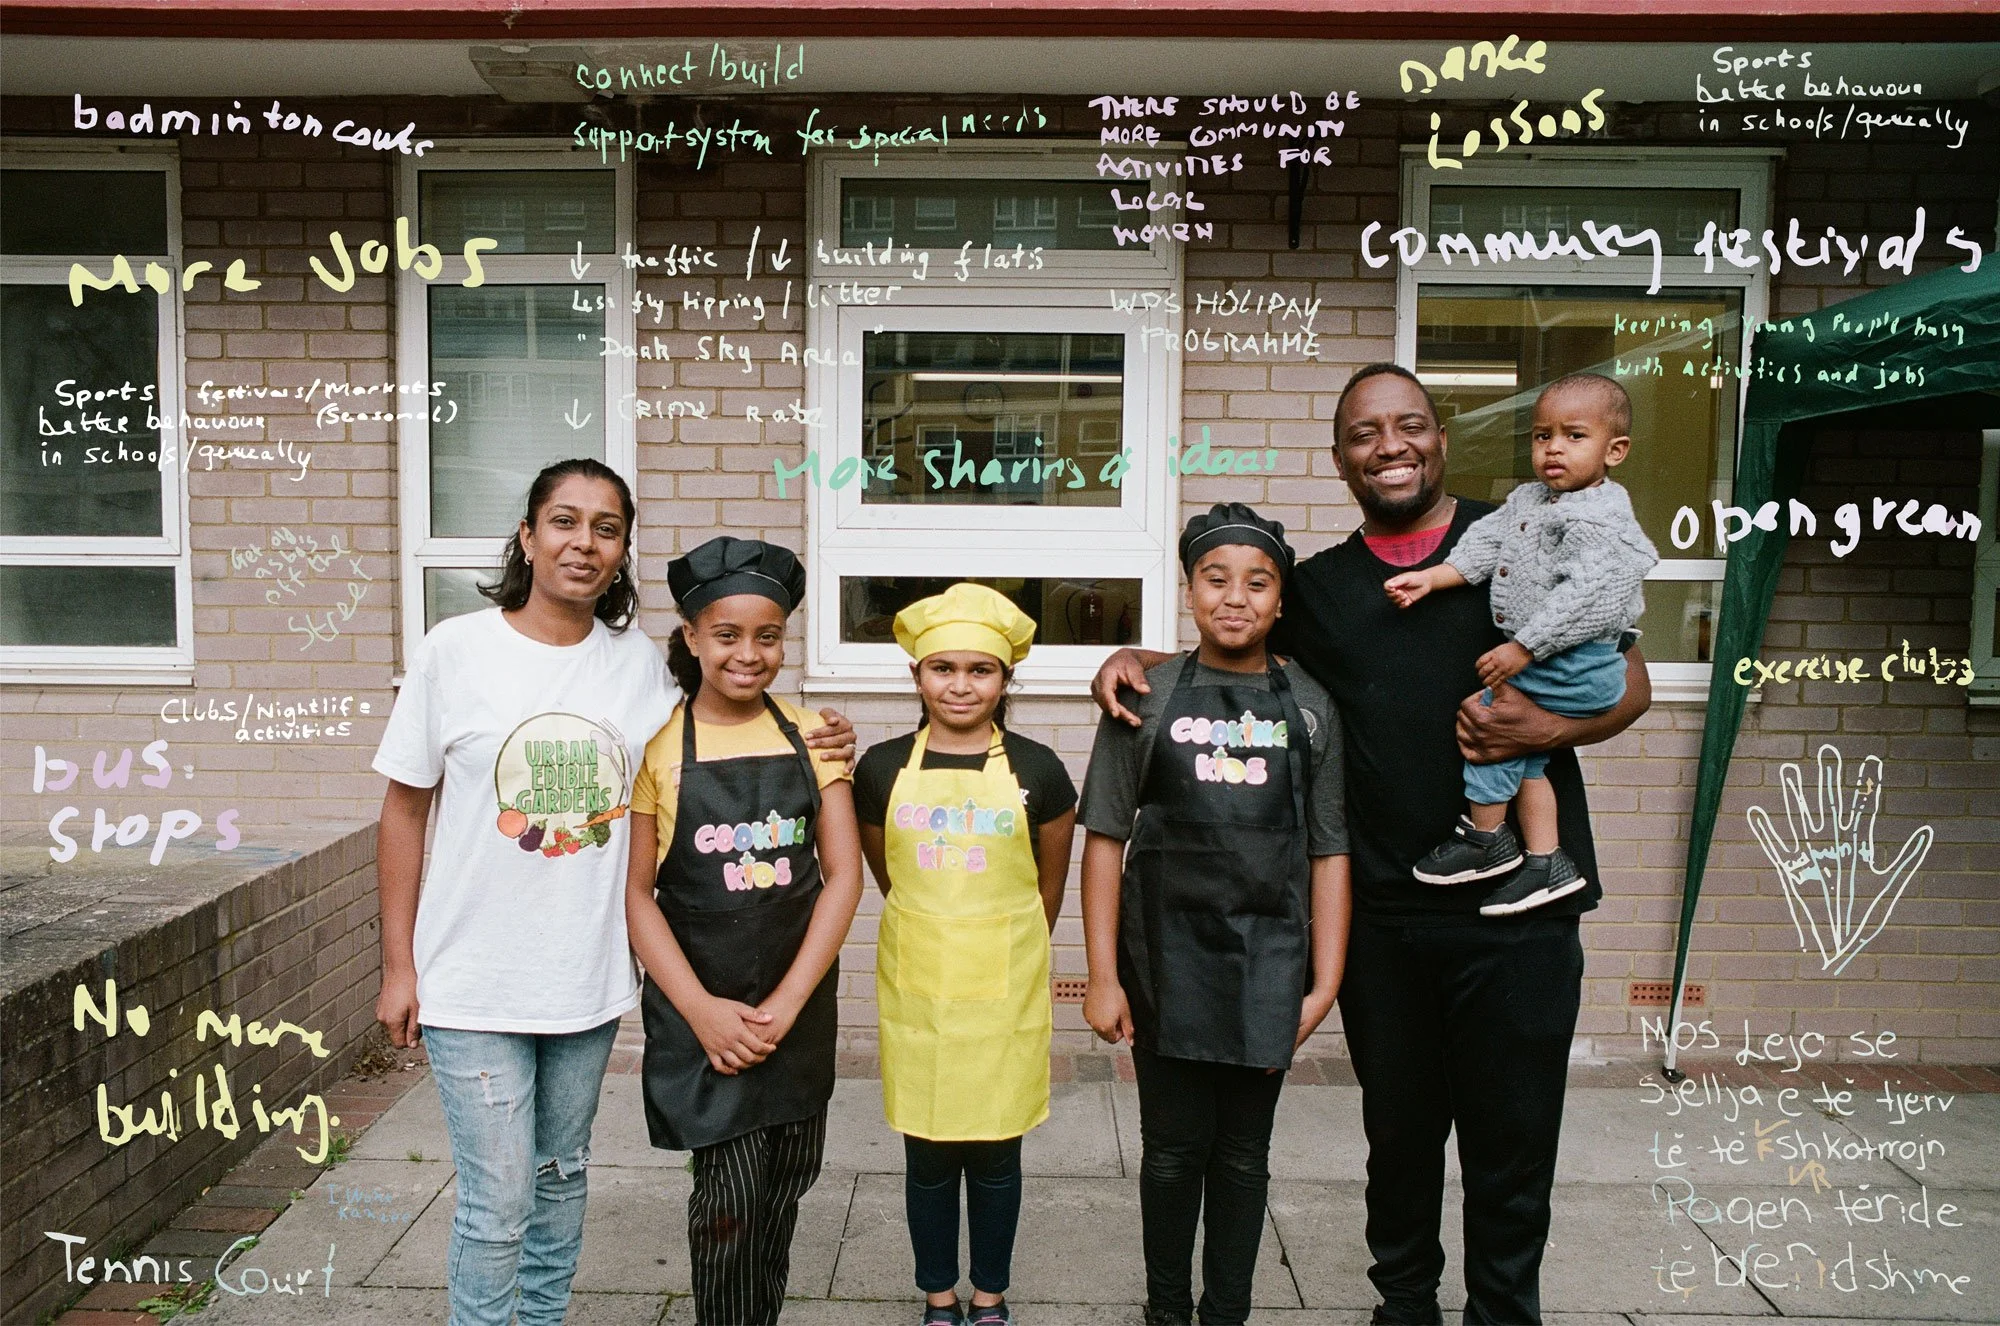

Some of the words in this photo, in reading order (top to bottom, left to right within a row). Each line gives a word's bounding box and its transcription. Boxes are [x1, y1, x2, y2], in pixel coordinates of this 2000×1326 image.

[1712, 46, 1813, 77] Sports
[74, 93, 323, 137] badminton
[1088, 94, 1180, 121] THERE
[1199, 90, 1307, 116] SHOULD
[1325, 90, 1361, 111] BE
[1698, 108, 1720, 132] in
[797, 107, 839, 156] for
[1100, 123, 1161, 148] MORE
[1190, 120, 1345, 147] COMMUNITY
[1096, 152, 1244, 180] ACTIVITIES
[1278, 146, 1333, 169] FOR
[1111, 188, 1205, 212] LOCAL
[1112, 222, 1214, 247] WOMEN
[621, 242, 718, 277] traffic
[817, 237, 930, 281] building
[953, 240, 1045, 282] flats
[69, 254, 262, 307] More
[631, 289, 665, 324] fly
[683, 290, 765, 321] tipping
[807, 281, 902, 309] litter
[694, 335, 753, 374] Sky
[1614, 355, 1664, 378] with
[1817, 361, 1858, 384] and
[1873, 361, 1926, 390] jobs
[55, 379, 157, 410] Sports
[40, 441, 63, 467] in
[773, 452, 898, 498] More
[1733, 653, 1871, 688] exercise
[1880, 638, 1976, 686] clubs
[234, 722, 353, 743] activities
[1170, 710, 1288, 749] COOKING
[524, 740, 598, 767] URBAN
[1195, 746, 1268, 785] KIDS
[531, 763, 599, 791] EDIBLE
[515, 787, 612, 815] GARDENS
[894, 797, 1016, 837] COOKING
[694, 809, 807, 854] COOKING
[723, 851, 792, 892] KIDS
[917, 833, 987, 873] KIDS
[73, 978, 151, 1038] No
[1849, 1030, 1899, 1059] se
[43, 1230, 194, 1286] Tennis
[214, 1234, 336, 1299] Court
